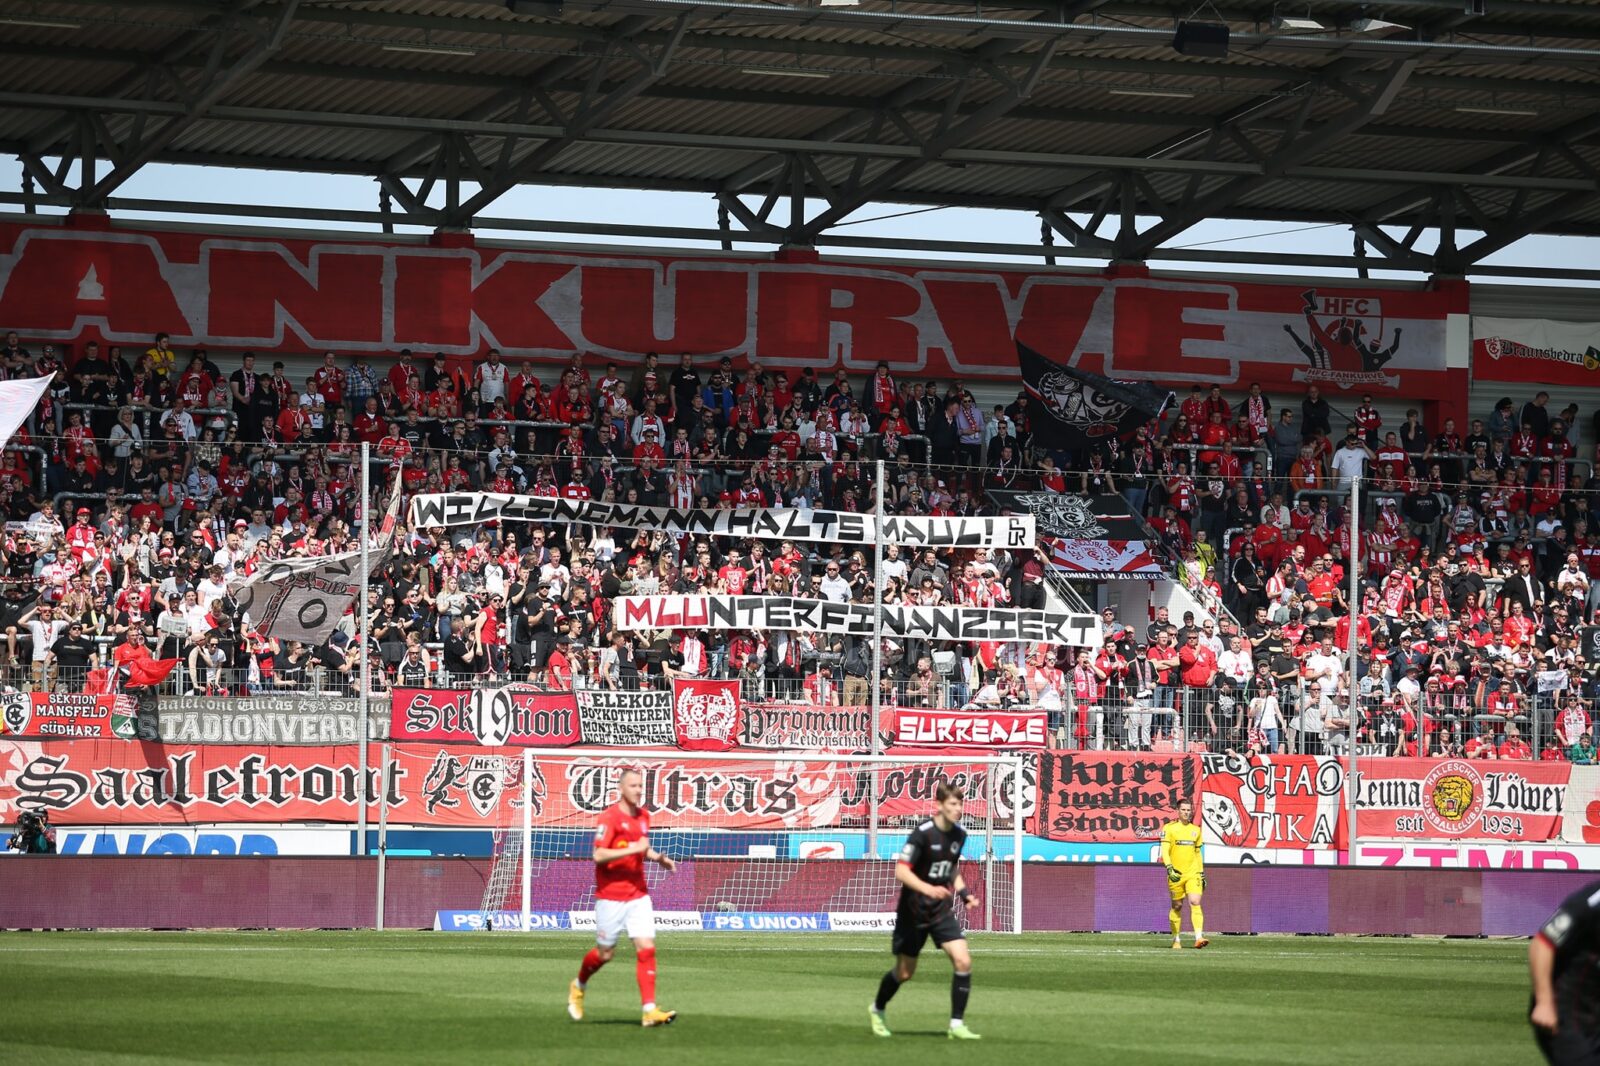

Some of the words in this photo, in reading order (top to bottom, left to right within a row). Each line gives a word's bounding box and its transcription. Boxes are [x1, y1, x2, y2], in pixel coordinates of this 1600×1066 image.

[1323, 297, 1369, 315] HFC
[1500, 339, 1584, 364] Braunsbedra
[415, 494, 722, 533] WILLINGMANN
[727, 508, 864, 542] HALTS
[873, 517, 994, 546] MAUL!
[1101, 572, 1116, 581] UM
[1118, 572, 1131, 581] ZU
[3, 693, 24, 705] HFC
[48, 693, 97, 705] SEKTION
[35, 704, 109, 718] MANSFELD
[581, 706, 671, 722] BOYKOTTIEREN
[39, 720, 102, 737] SÜDHARZ
[582, 720, 673, 736] MONTAGSSPIELE
[739, 706, 870, 744] Pyromanie
[900, 715, 1044, 742] SURREALE
[584, 733, 612, 745] NICHT
[765, 735, 783, 745] ist
[789, 731, 871, 748] Leidenschaft
[15, 750, 409, 808] Saalefront
[1055, 752, 1181, 786] kurt
[1246, 759, 1344, 799] CHAO
[1426, 762, 1480, 786] HALLESCHER
[1057, 785, 1181, 810] wabbel
[1345, 771, 1422, 808] Leuna
[1396, 813, 1425, 832] seit
[1481, 814, 1523, 836] 1984
[1423, 794, 1476, 832] FUSSBALLCLUB
[1249, 811, 1336, 844] TIKA
[452, 913, 483, 928] PS
[653, 916, 700, 927] Region
[714, 915, 744, 929] PS
[750, 915, 818, 929] UNION
[834, 917, 882, 927] bewegt
